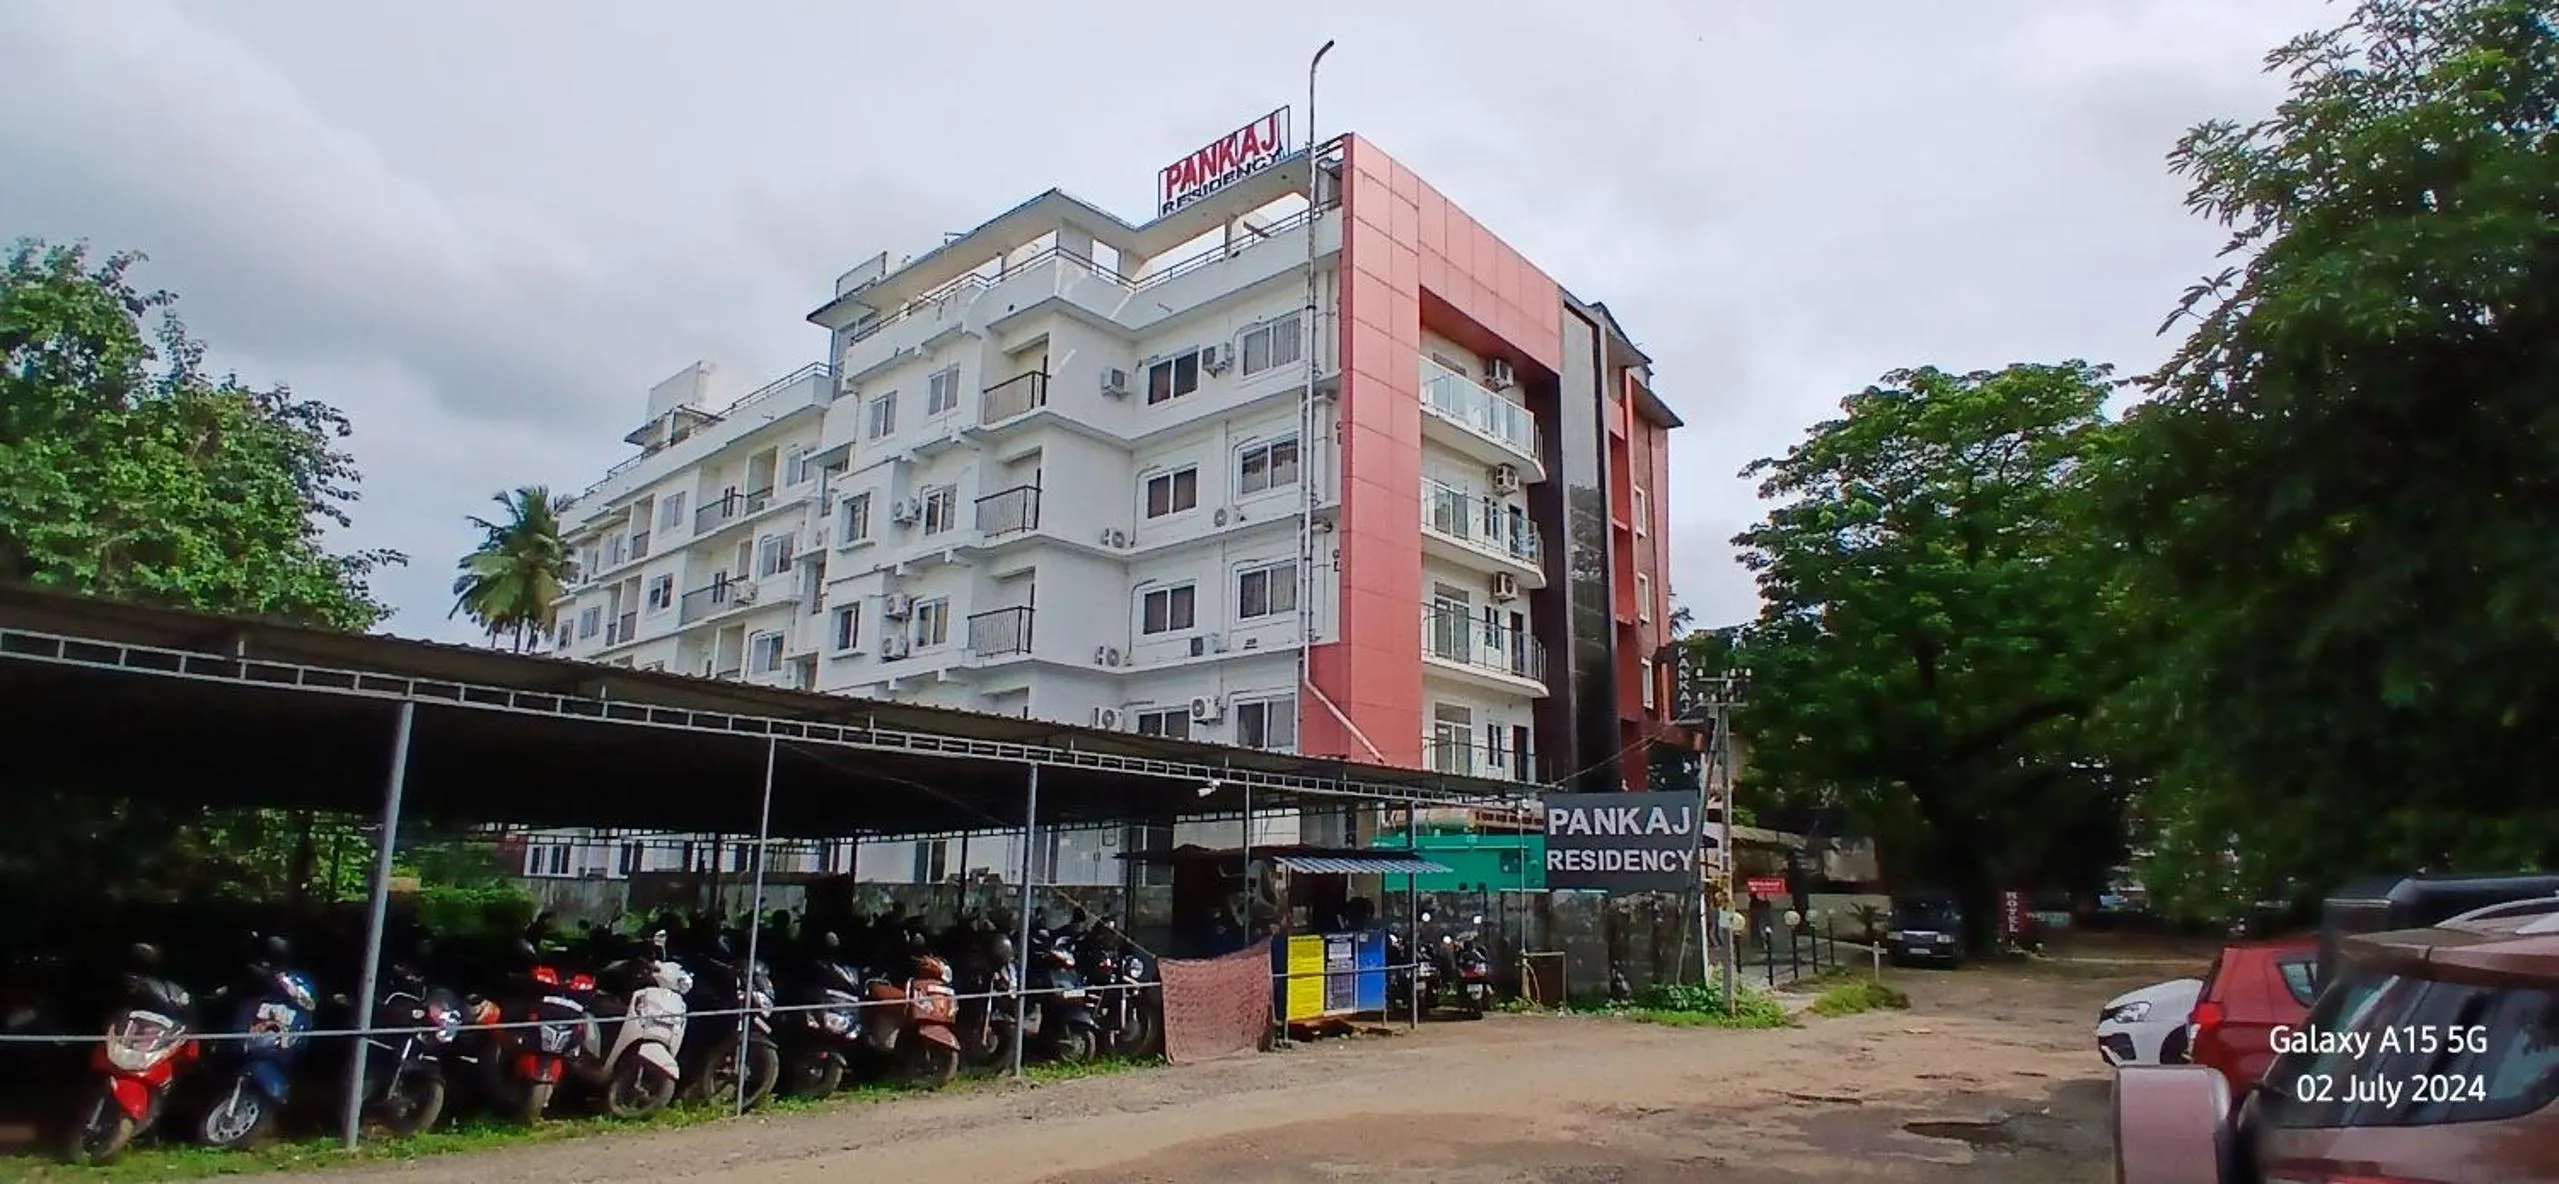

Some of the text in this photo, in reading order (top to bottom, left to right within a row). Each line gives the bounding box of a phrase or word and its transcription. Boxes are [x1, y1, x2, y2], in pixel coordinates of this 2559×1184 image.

[1162, 151, 1282, 214] RESIDENCY
[1166, 112, 1278, 200] PANKAJ
[1678, 647, 1691, 712] PANKAJ
[1549, 806, 1691, 835] PANKAJ
[1547, 849, 1693, 872] RESIDENCY
